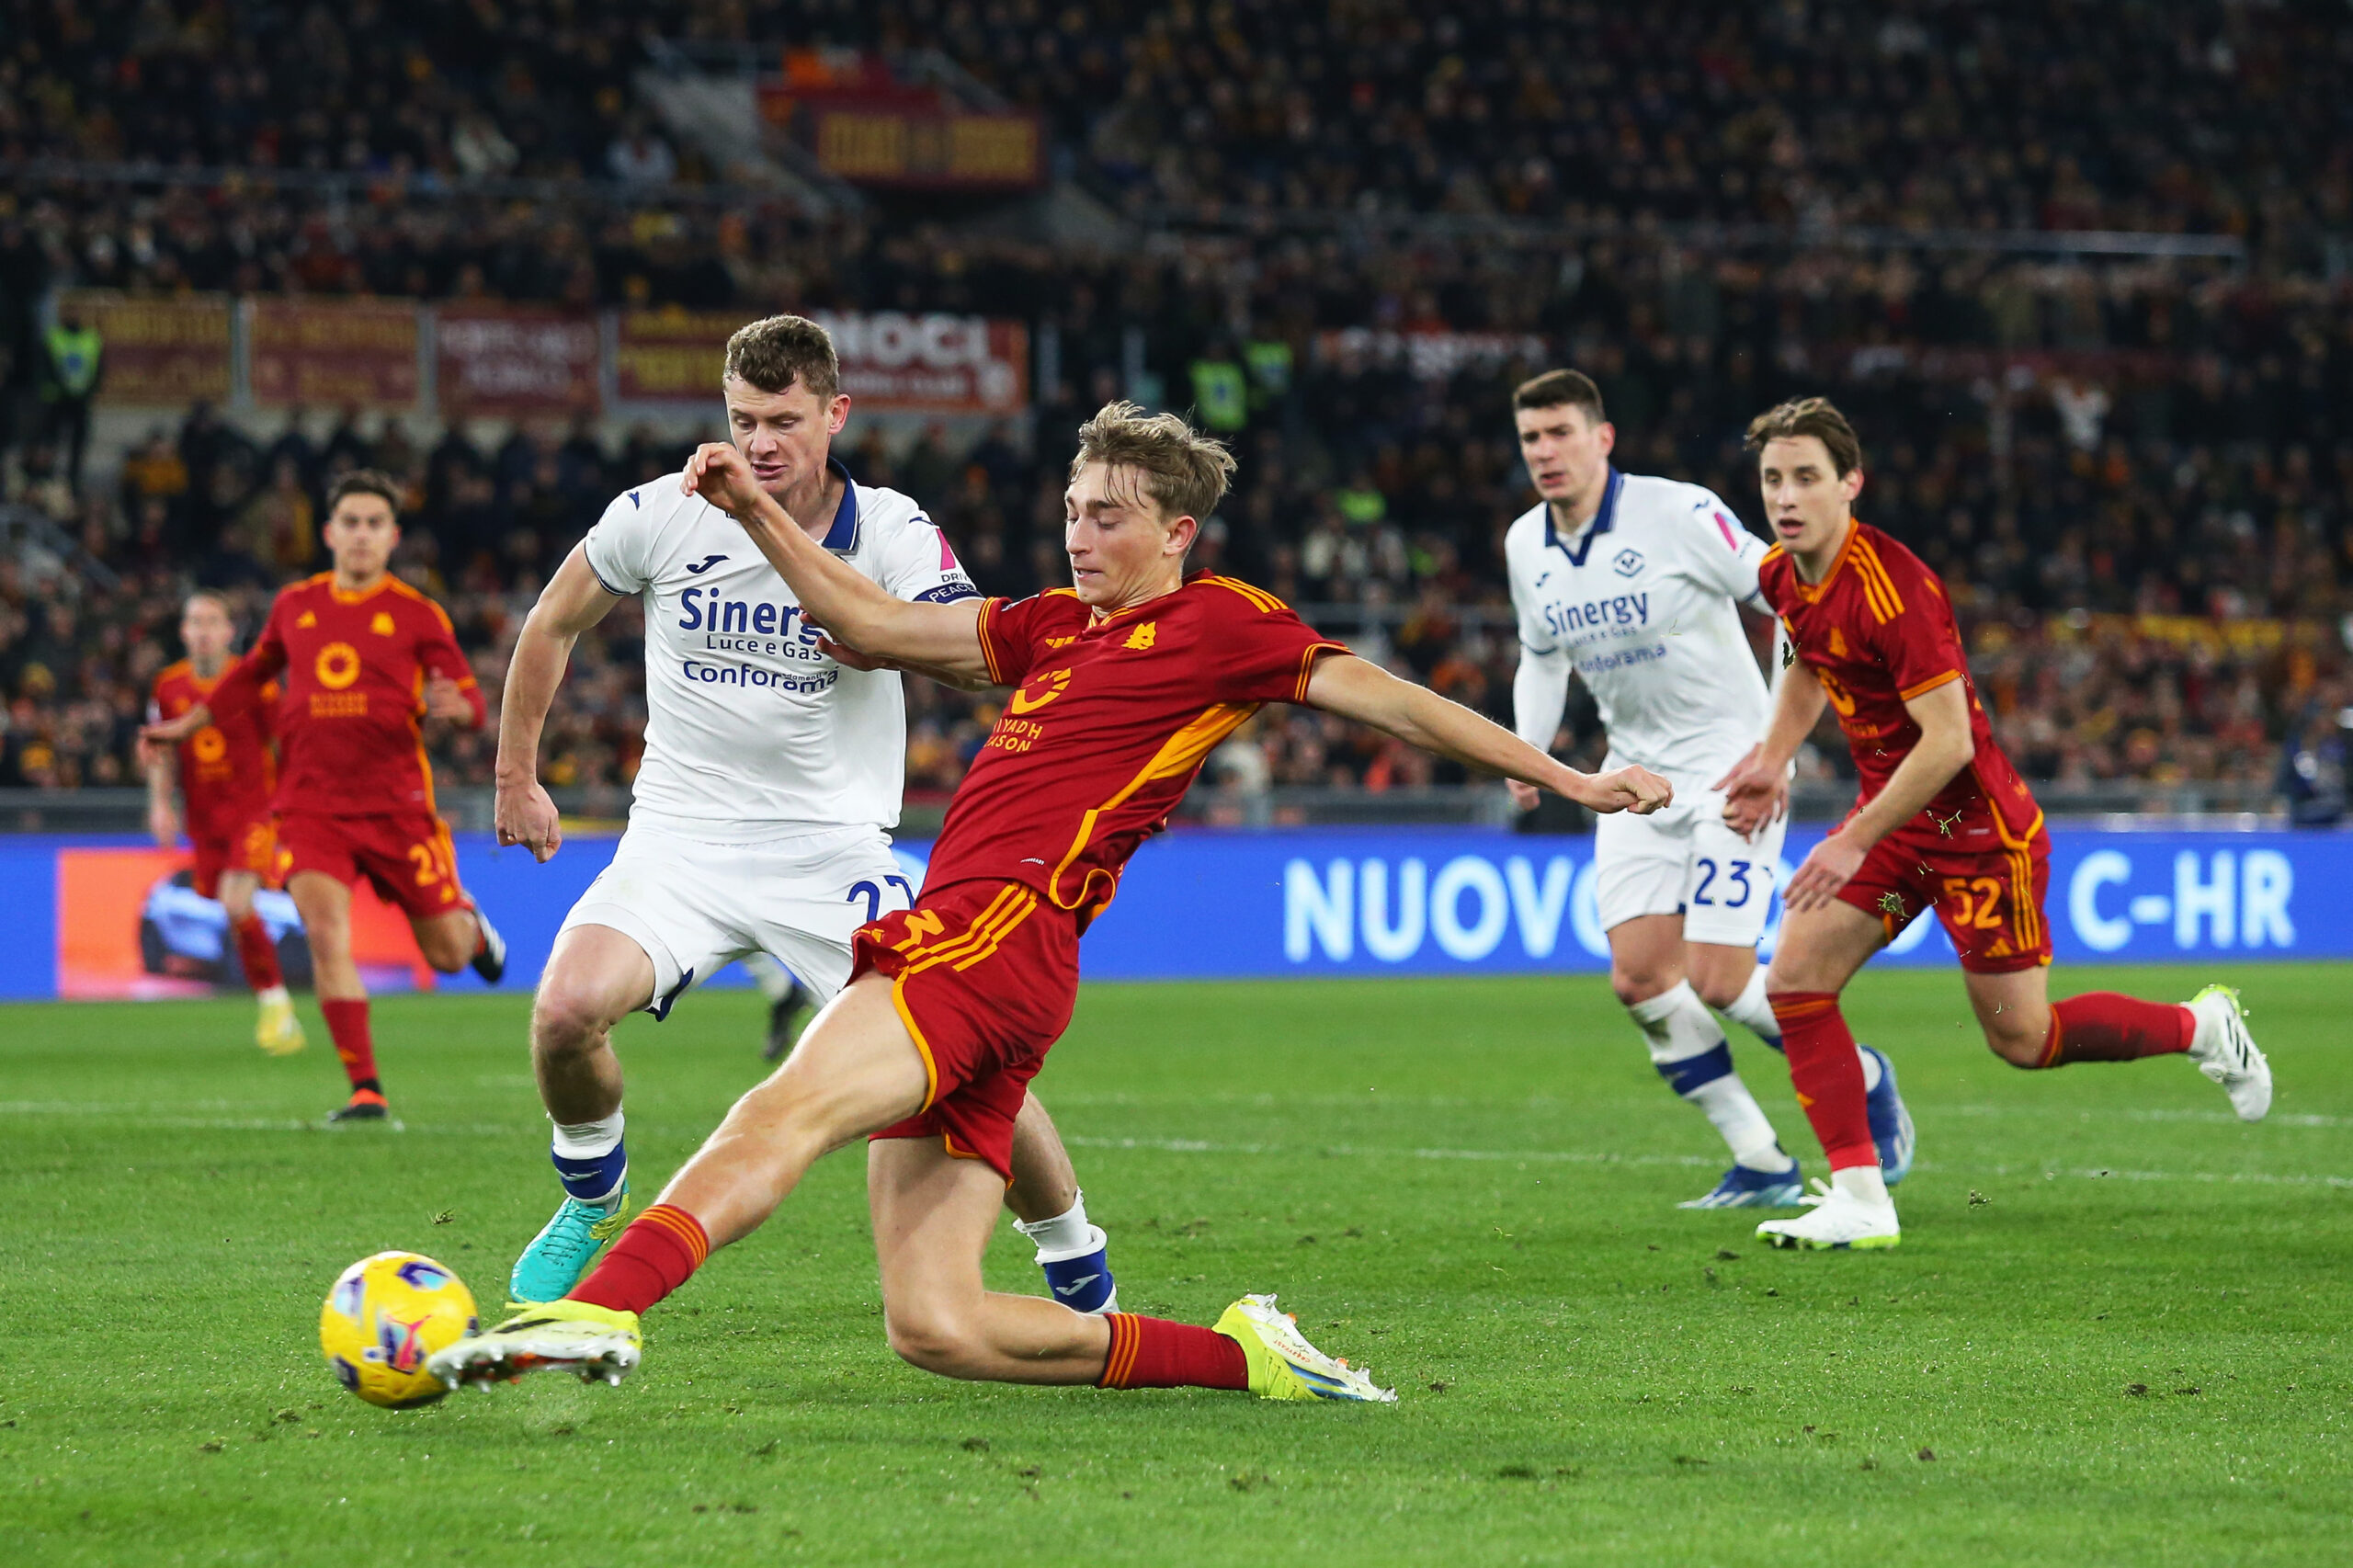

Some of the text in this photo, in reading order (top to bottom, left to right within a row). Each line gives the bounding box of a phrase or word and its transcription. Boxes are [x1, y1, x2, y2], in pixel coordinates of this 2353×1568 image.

[941, 574, 971, 583] DRIV
[678, 587, 825, 645] Siner
[1545, 593, 1648, 636] Sinergy
[707, 635, 823, 661] Luce e Gas
[683, 661, 838, 694] Conforama
[983, 734, 1031, 753] ASON
[1694, 857, 1750, 908] 23
[1942, 876, 2003, 930] 52
[2067, 849, 2295, 952] C-HR
